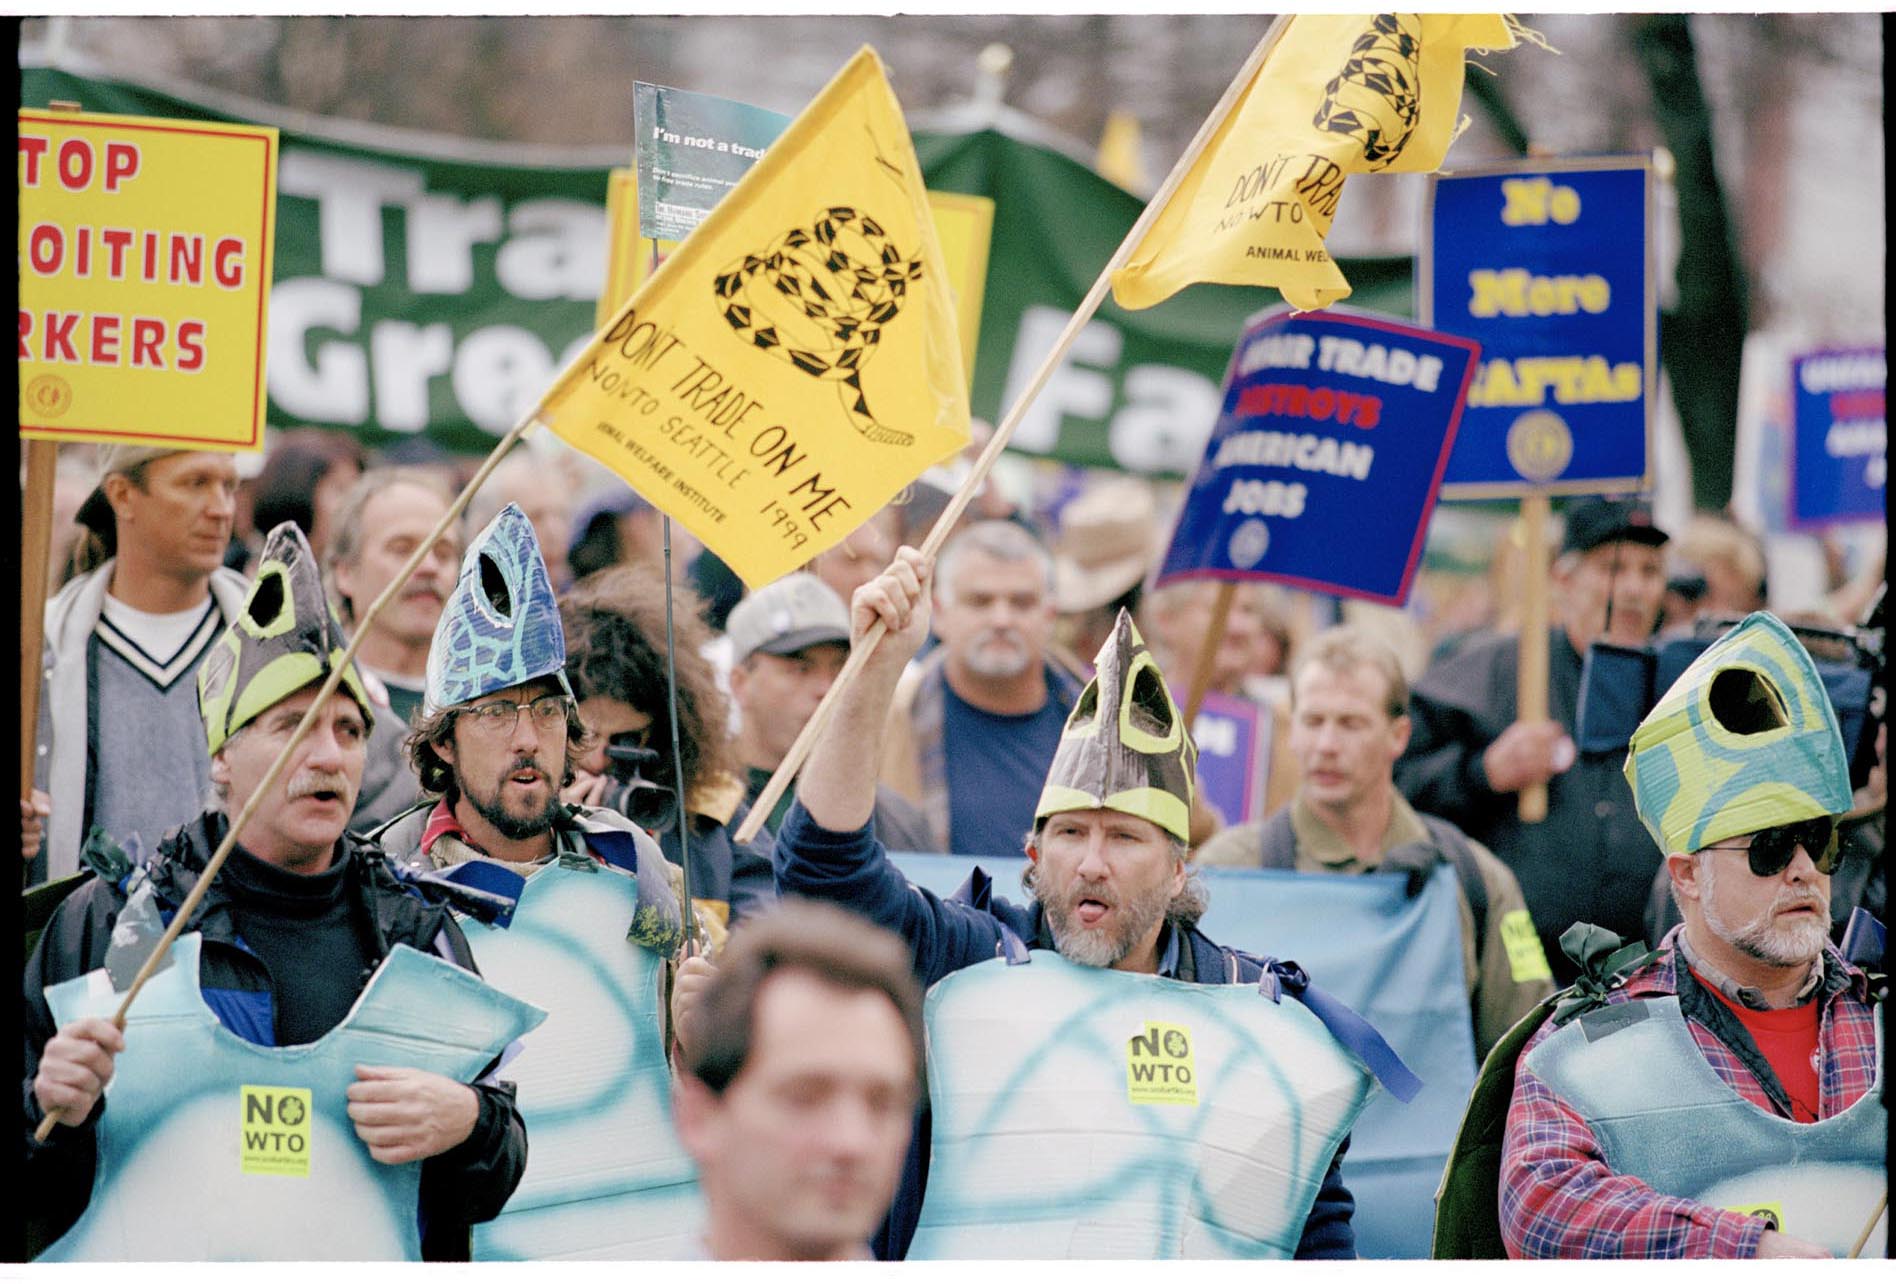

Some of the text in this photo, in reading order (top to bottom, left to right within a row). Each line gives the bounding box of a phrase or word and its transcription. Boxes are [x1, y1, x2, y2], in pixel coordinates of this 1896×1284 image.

[653, 126, 681, 144] I'm
[684, 134, 715, 150] not
[718, 143, 729, 153] a
[1296, 153, 1346, 217] TRAD
[1501, 176, 1581, 227] No
[28, 222, 247, 290] OITING
[1246, 245, 1301, 262] ANIMAL
[1467, 268, 1611, 318] More
[1318, 336, 1443, 393] TRADE
[671, 355, 764, 440] TRADE
[750, 425, 808, 478] ON
[788, 472, 852, 532] ME
[659, 415, 751, 489] SEATTLE
[760, 499, 809, 551] 1999
[673, 478, 728, 524] INSTITUTE
[1131, 1027, 1189, 1058] NO
[1131, 1063, 1192, 1084] WTO
[246, 1093, 305, 1126] NO
[246, 1130, 305, 1153] WTO
